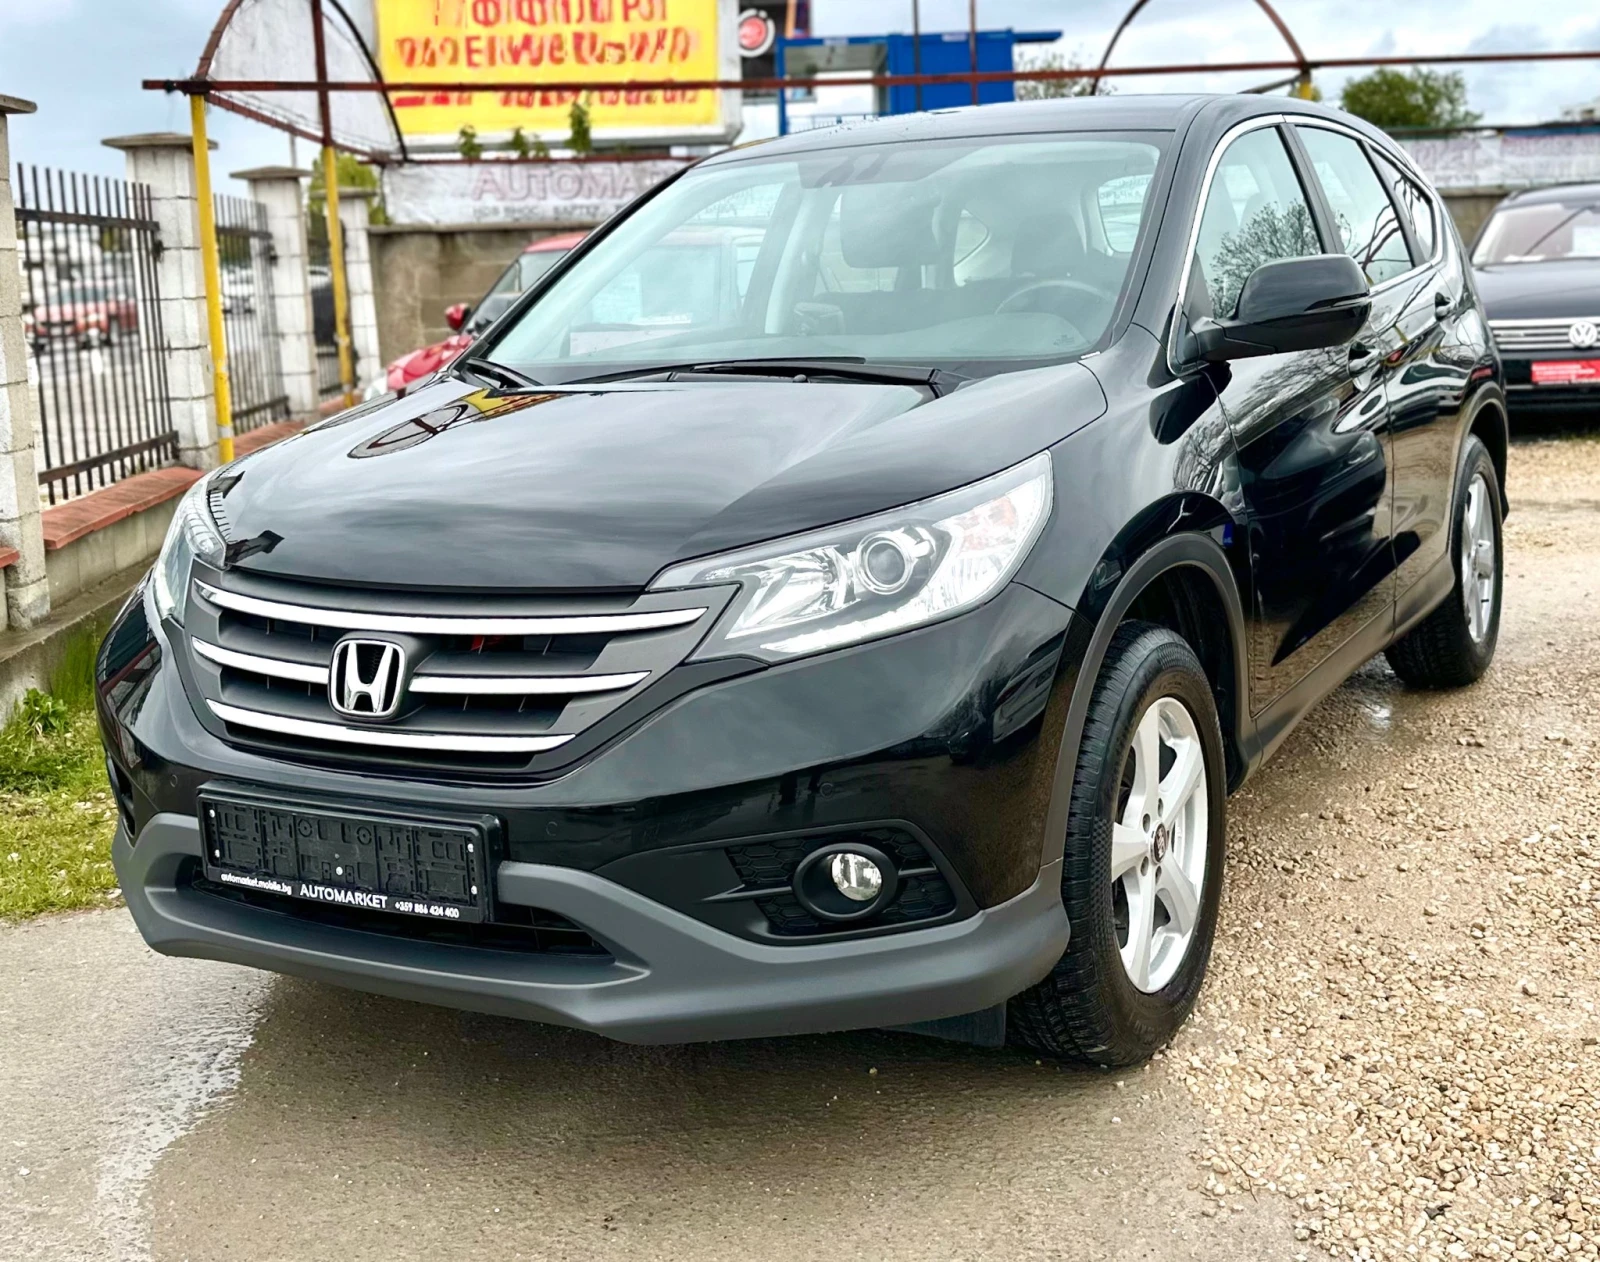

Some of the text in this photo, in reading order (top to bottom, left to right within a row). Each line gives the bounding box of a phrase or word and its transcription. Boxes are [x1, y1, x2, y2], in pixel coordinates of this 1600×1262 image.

[220, 873, 460, 919] automarket.mobile.bg AUTOMARKET +359 886 424 400
